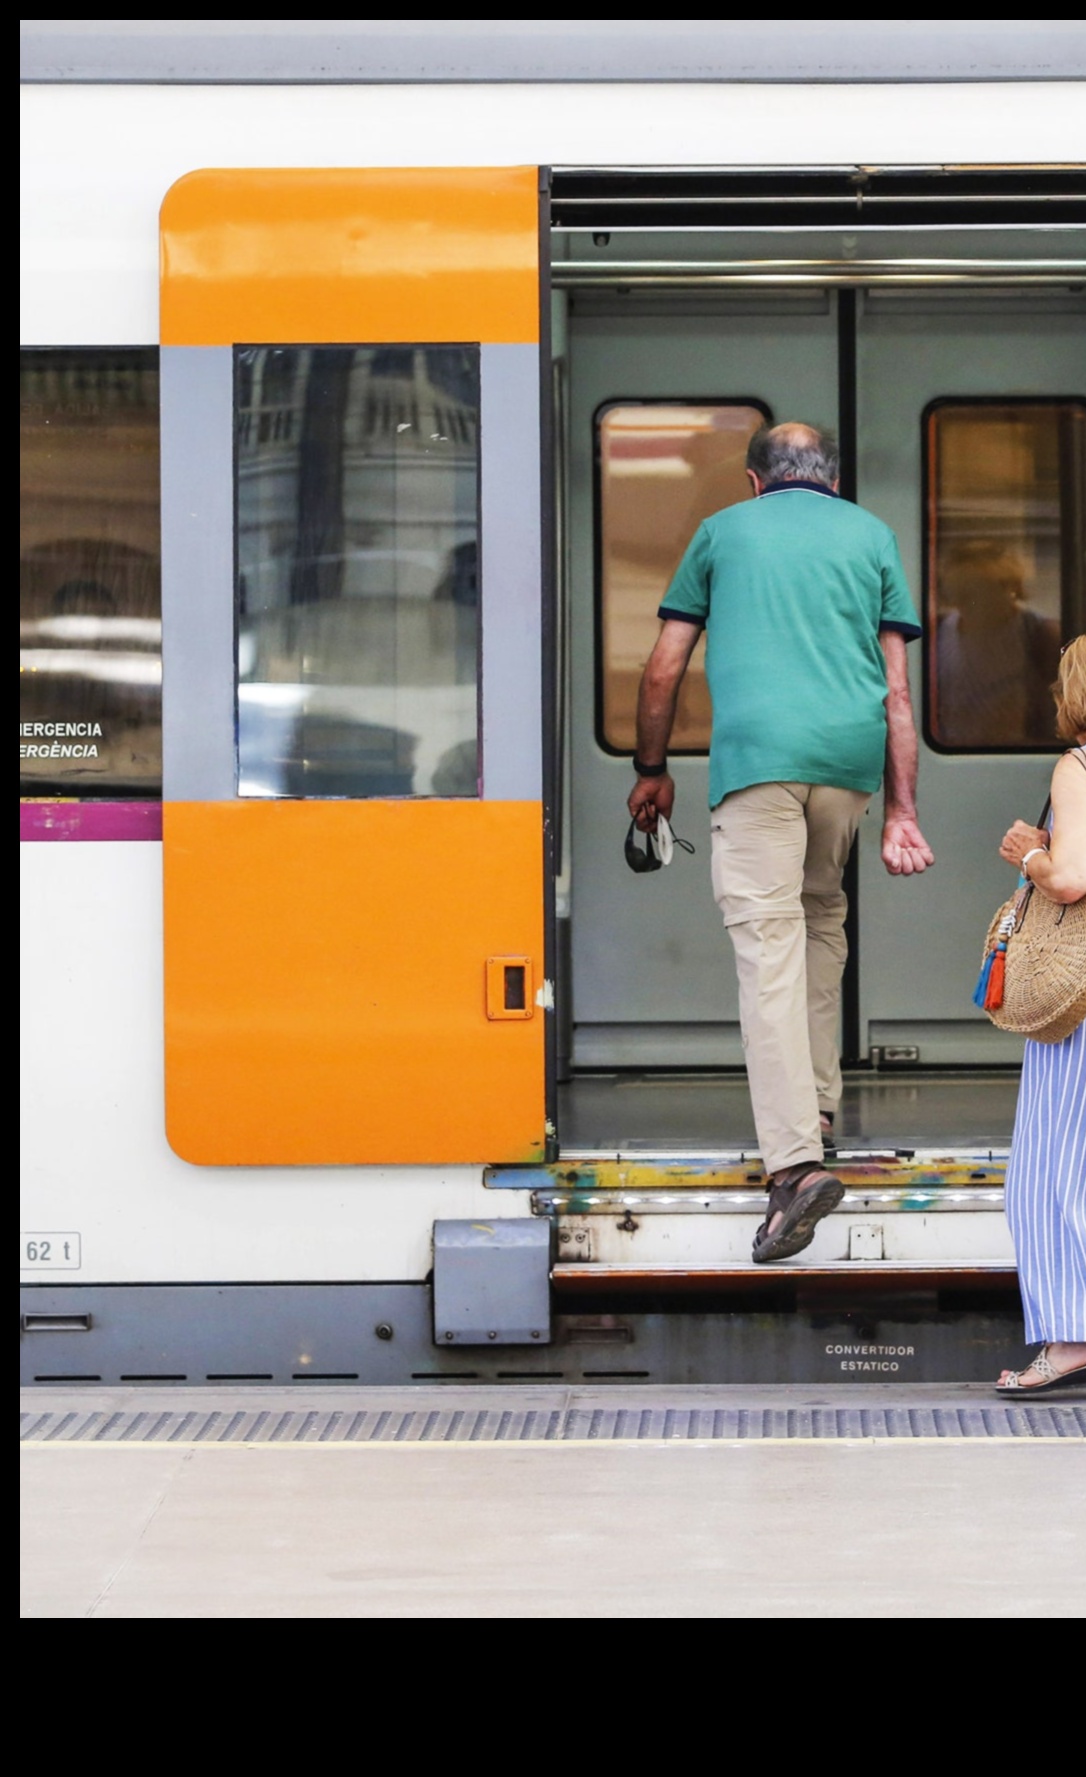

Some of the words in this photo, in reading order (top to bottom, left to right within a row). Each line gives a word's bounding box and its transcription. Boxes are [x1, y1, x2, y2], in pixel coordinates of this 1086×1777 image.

[20, 722, 102, 737] ERGENCIA
[26, 1241, 51, 1261] 62
[63, 1241, 70, 1261] t
[825, 1344, 915, 1356] CONVERTIDOR
[840, 1360, 899, 1372] ESTATICO
